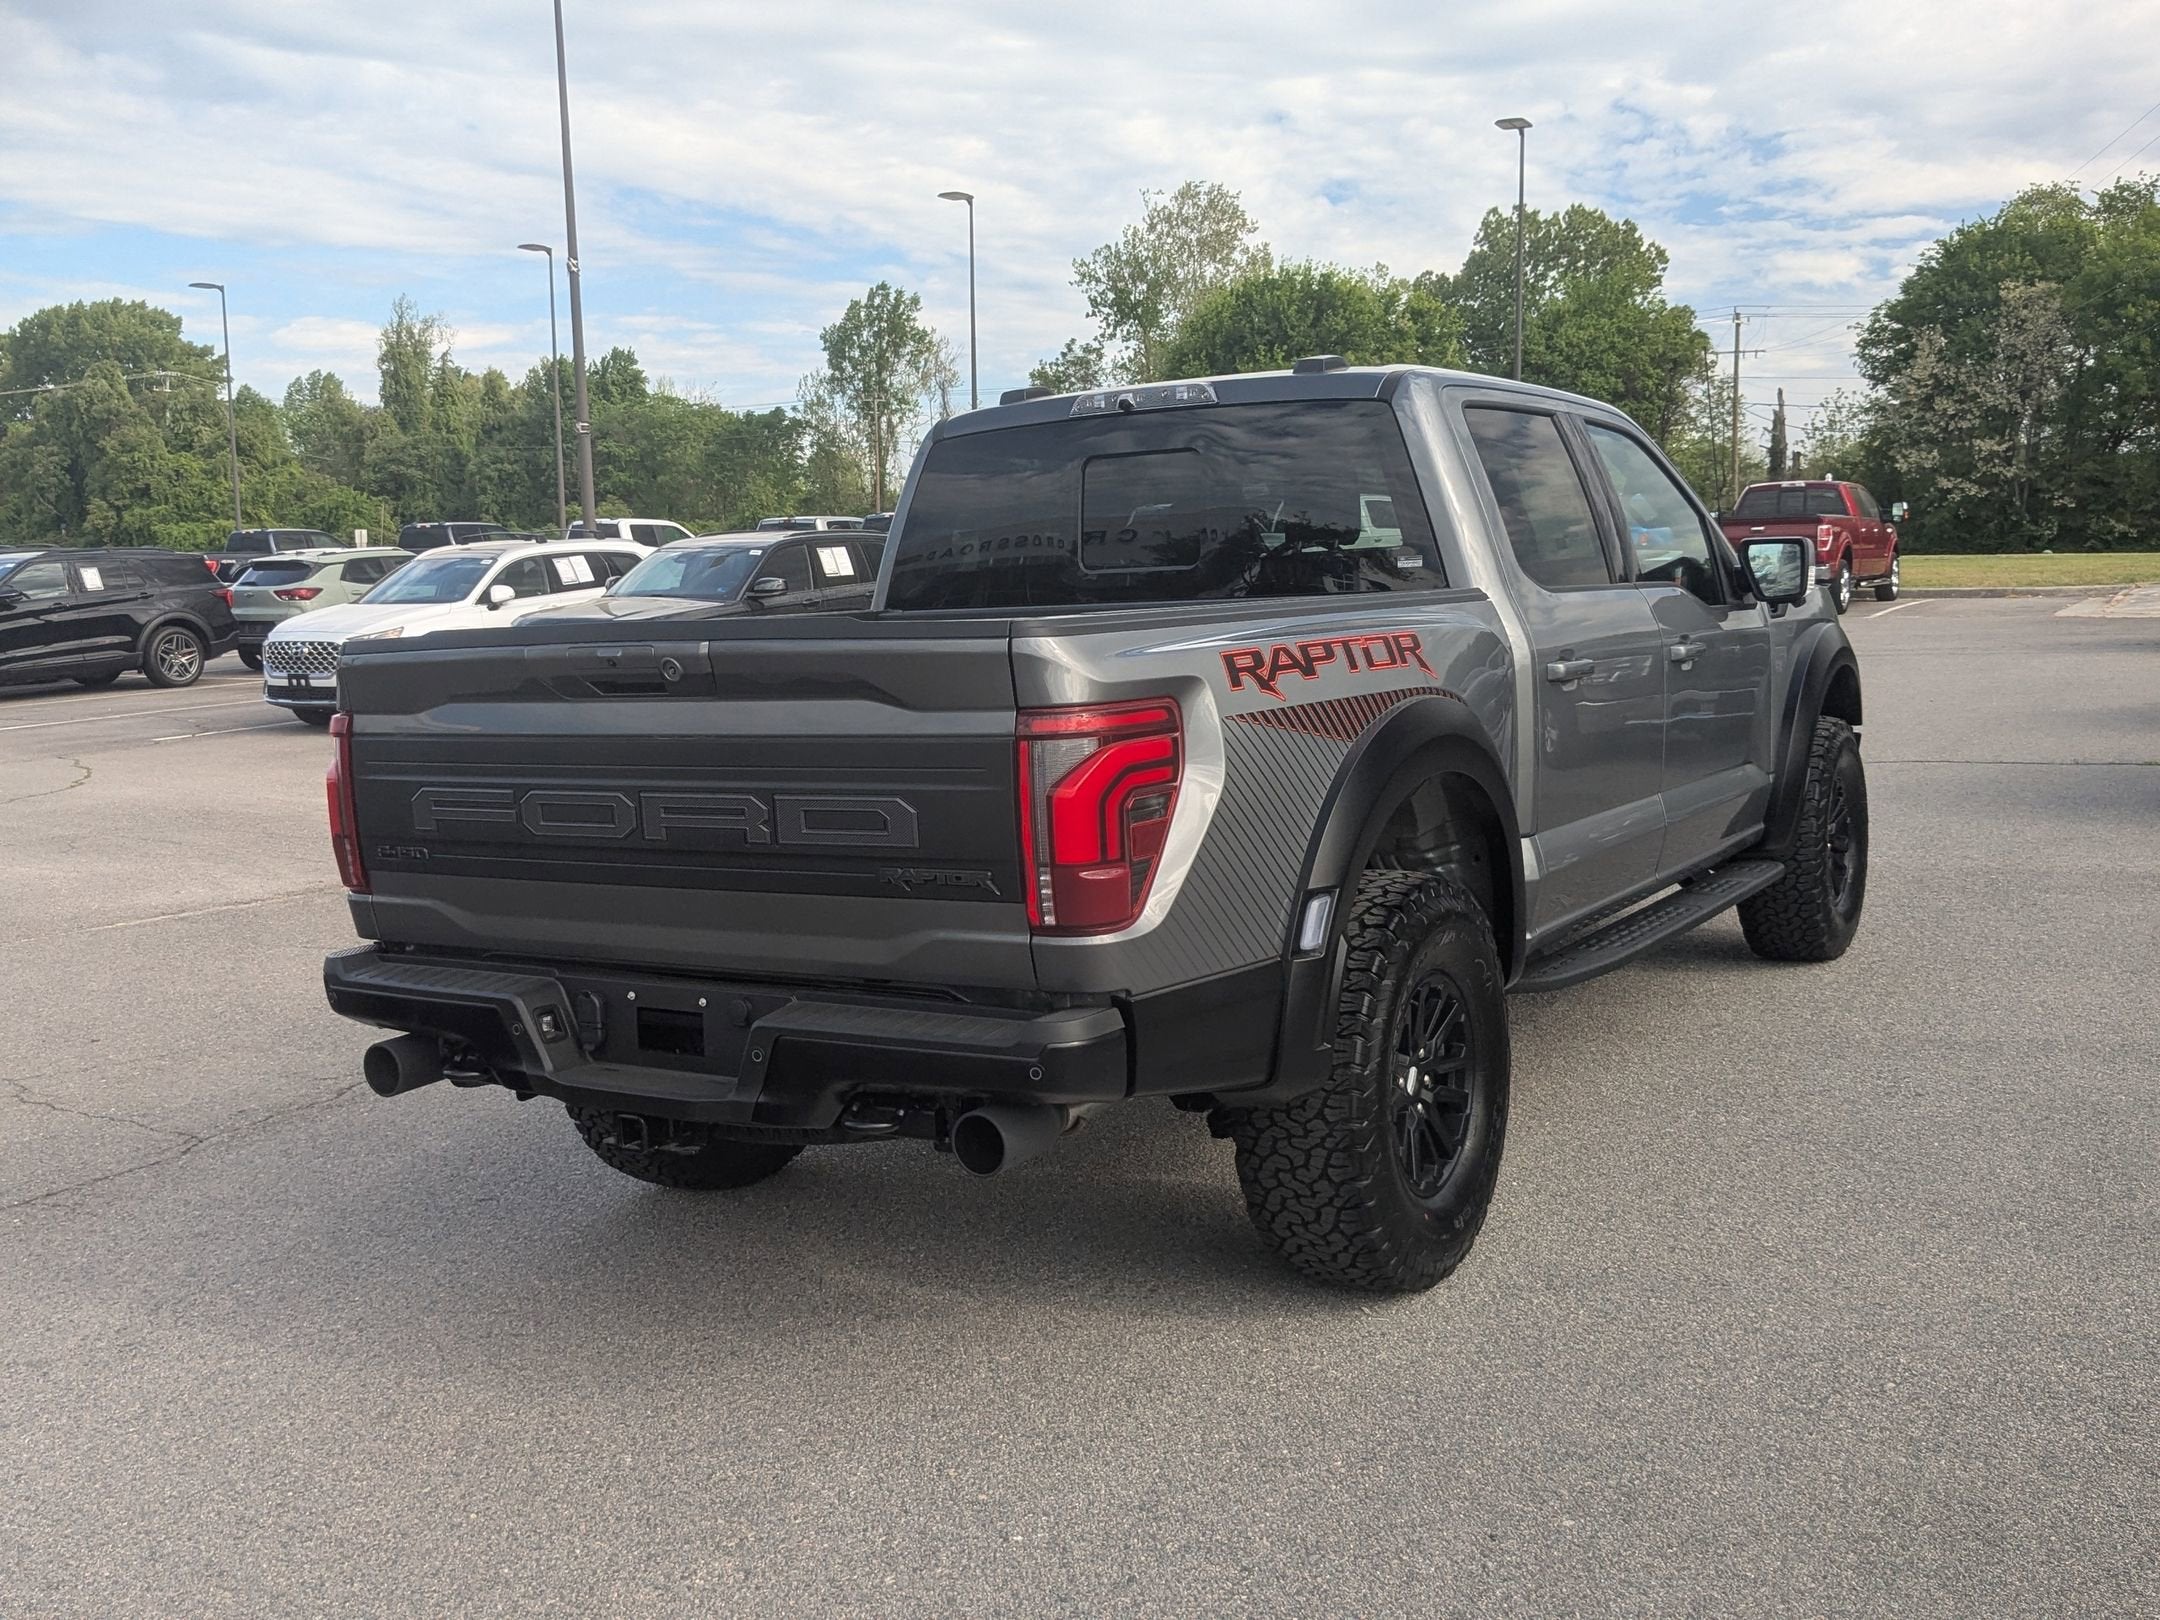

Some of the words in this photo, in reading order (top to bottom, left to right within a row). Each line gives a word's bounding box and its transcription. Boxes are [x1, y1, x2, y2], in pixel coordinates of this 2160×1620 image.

[1219, 630, 1438, 702] RAPTOR
[410, 787, 920, 848] FORD
[880, 866, 1001, 896] RAPTOR
